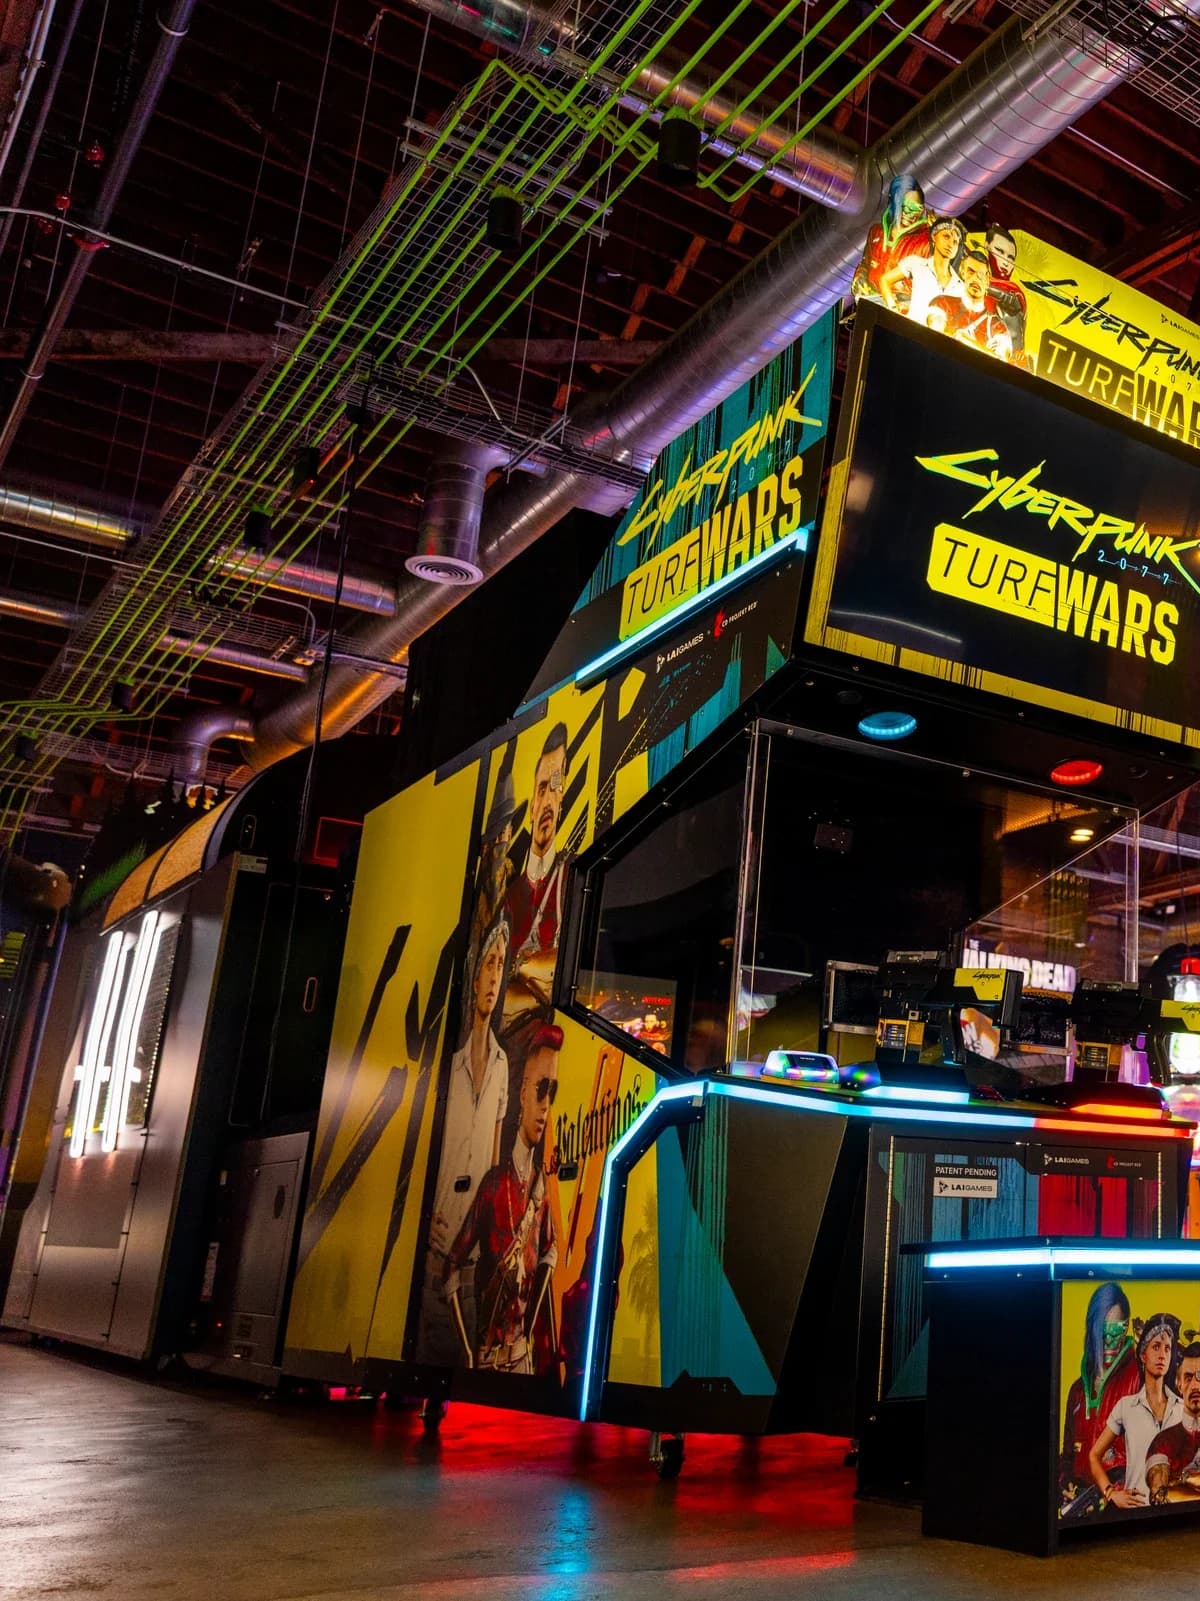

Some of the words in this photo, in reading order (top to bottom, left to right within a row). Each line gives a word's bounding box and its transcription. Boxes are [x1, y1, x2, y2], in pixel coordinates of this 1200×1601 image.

[1049, 340, 1136, 412] TURF
[628, 541, 700, 624] TURF
[700, 455, 803, 587] WARS
[1097, 549, 1170, 585] 2077
[944, 537, 1057, 610] TURF
[1056, 564, 1180, 666] WARS
[935, 1166, 962, 1176] PATENT
[964, 1167, 997, 1177] PENDING
